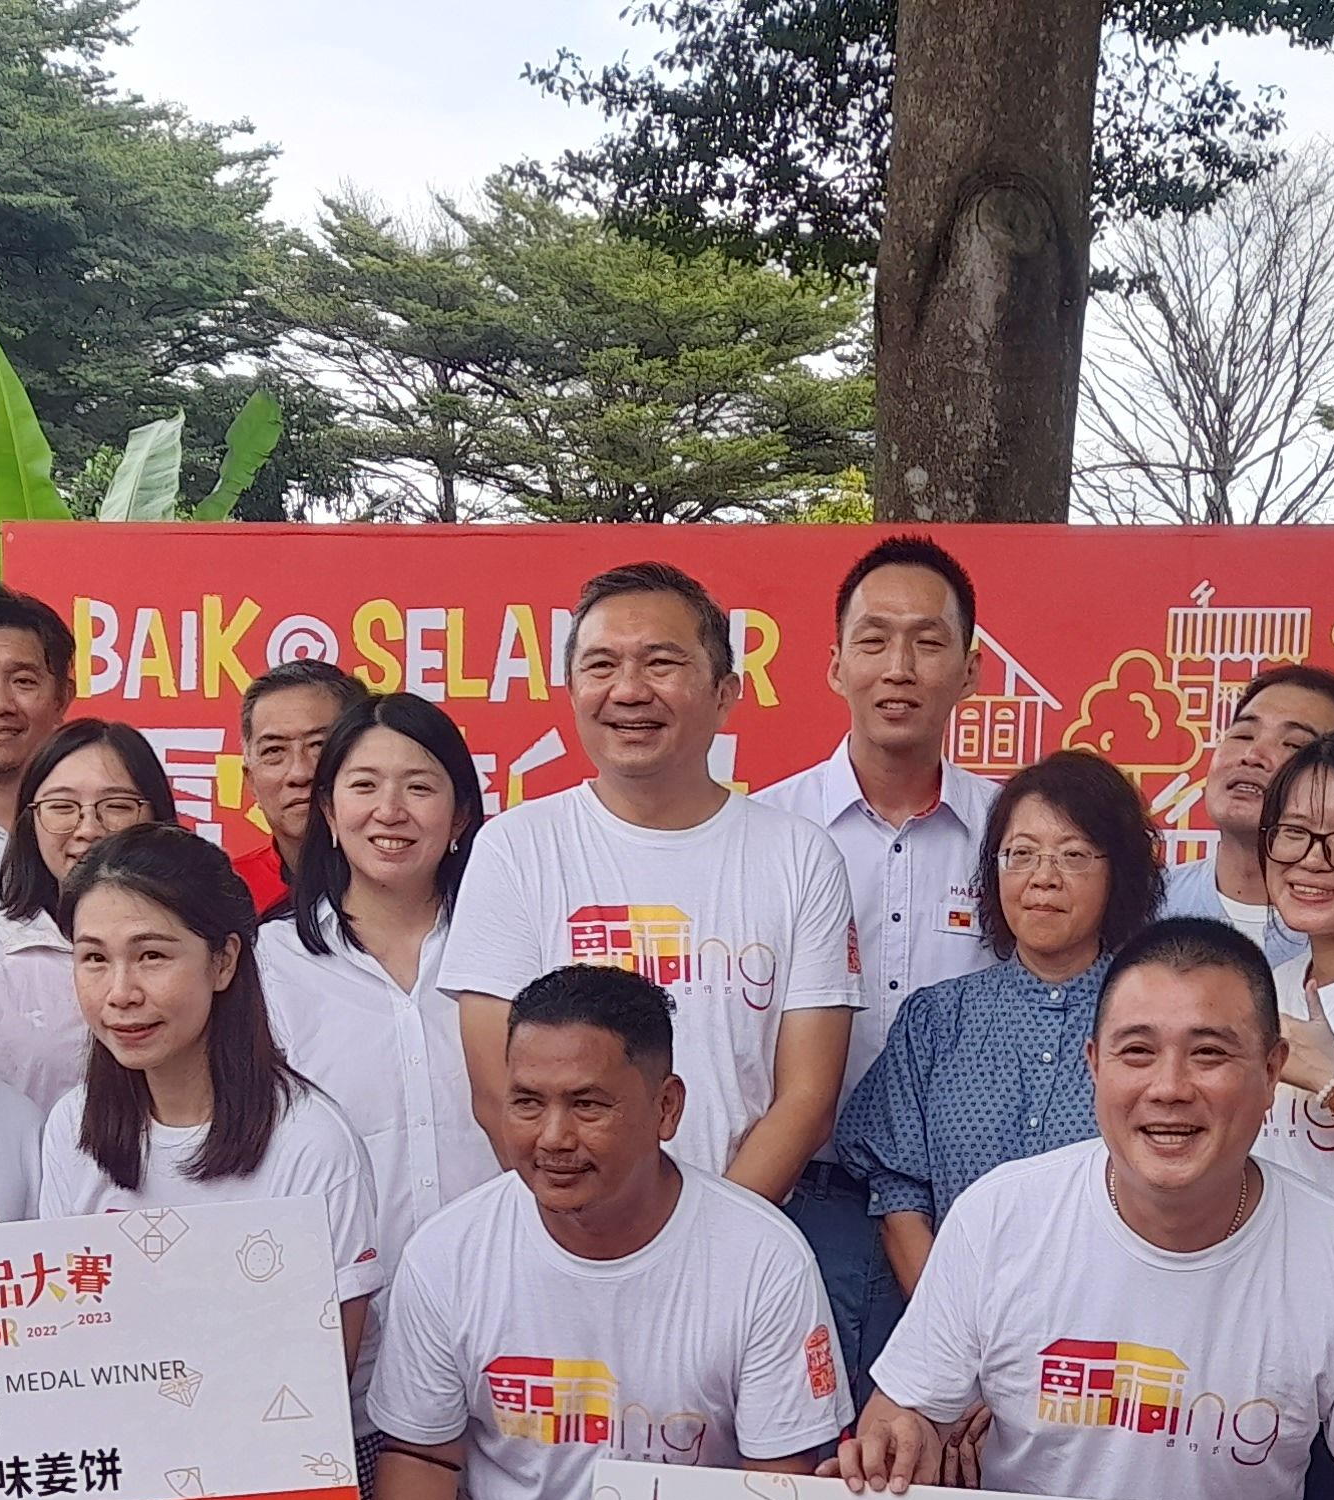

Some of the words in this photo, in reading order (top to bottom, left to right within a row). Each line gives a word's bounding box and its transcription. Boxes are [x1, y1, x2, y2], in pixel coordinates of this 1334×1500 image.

[26, 1324, 58, 1339] 2022
[77, 1311, 112, 1326] 2023
[5, 1367, 85, 1394] MEDAL
[91, 1359, 187, 1386] WINNER
